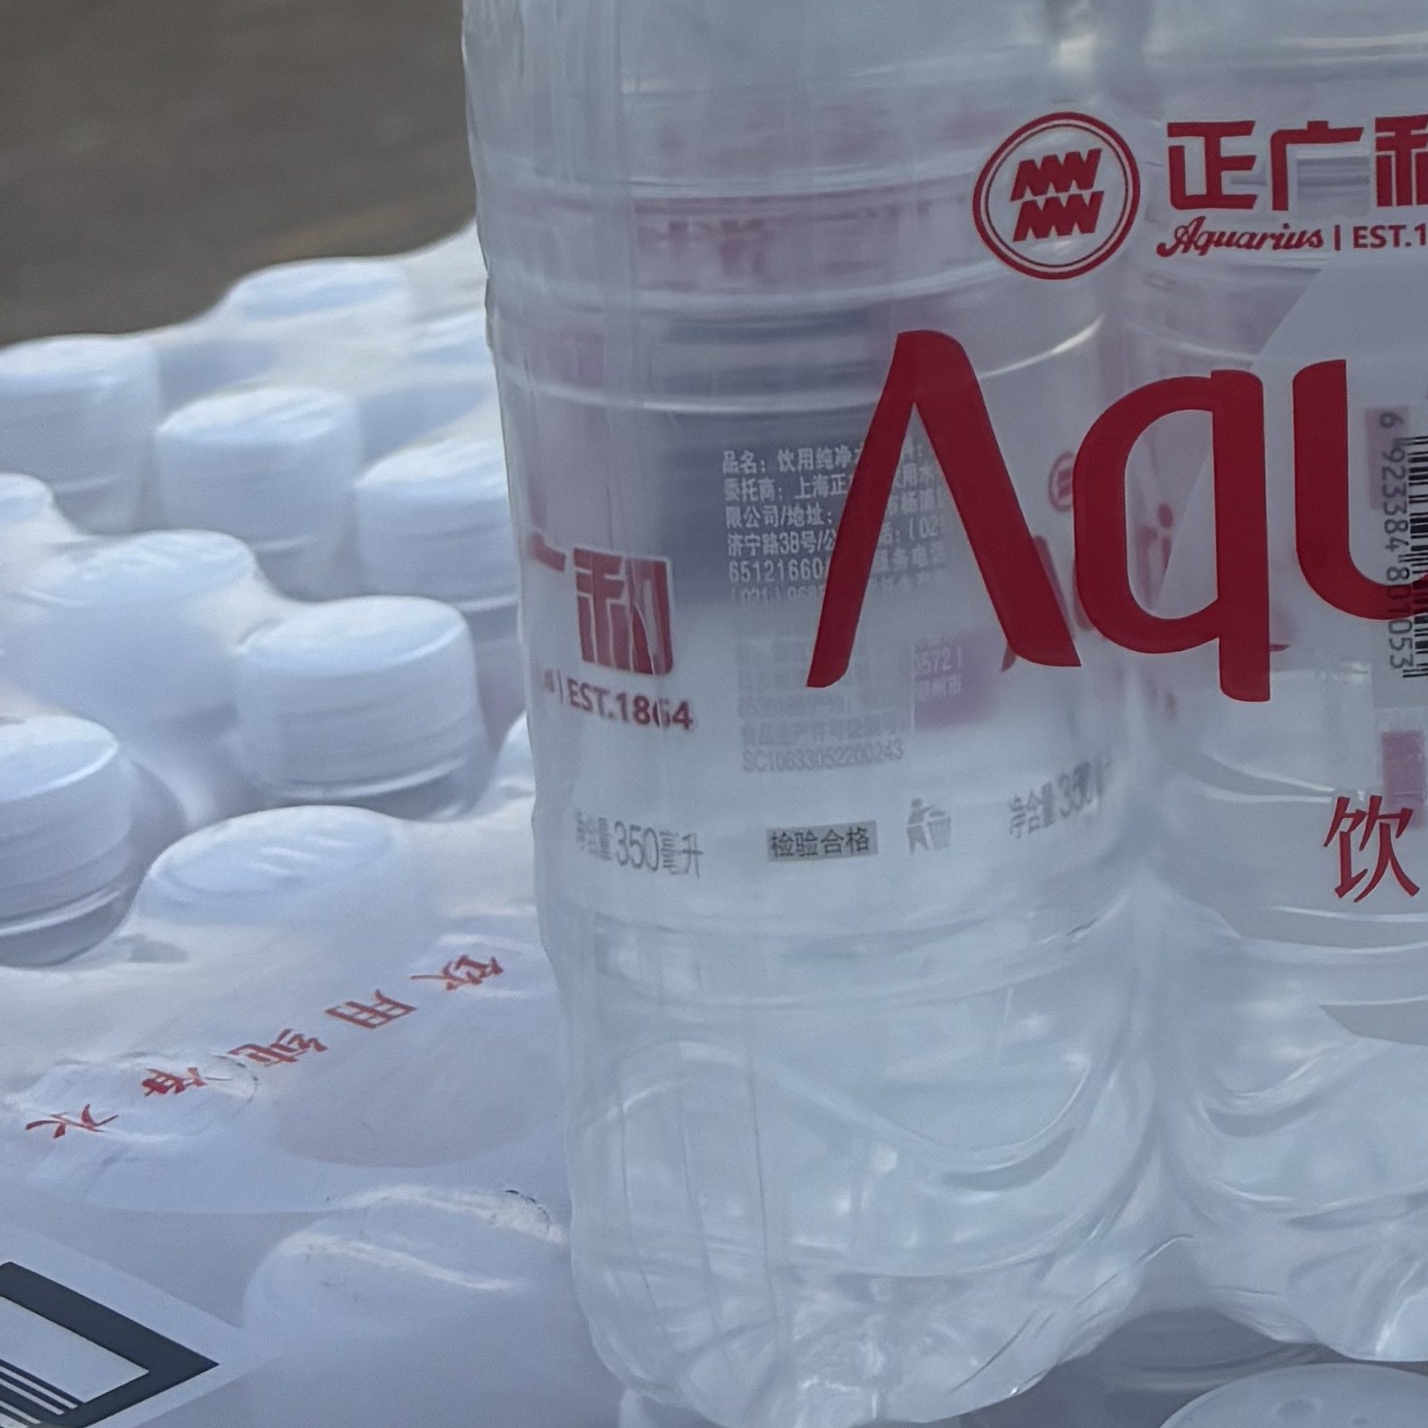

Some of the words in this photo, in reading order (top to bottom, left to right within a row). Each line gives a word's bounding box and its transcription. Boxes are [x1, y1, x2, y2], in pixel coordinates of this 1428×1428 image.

[1156, 215, 1325, 259] Aquarius
[769, 825, 874, 861] 检验合格
